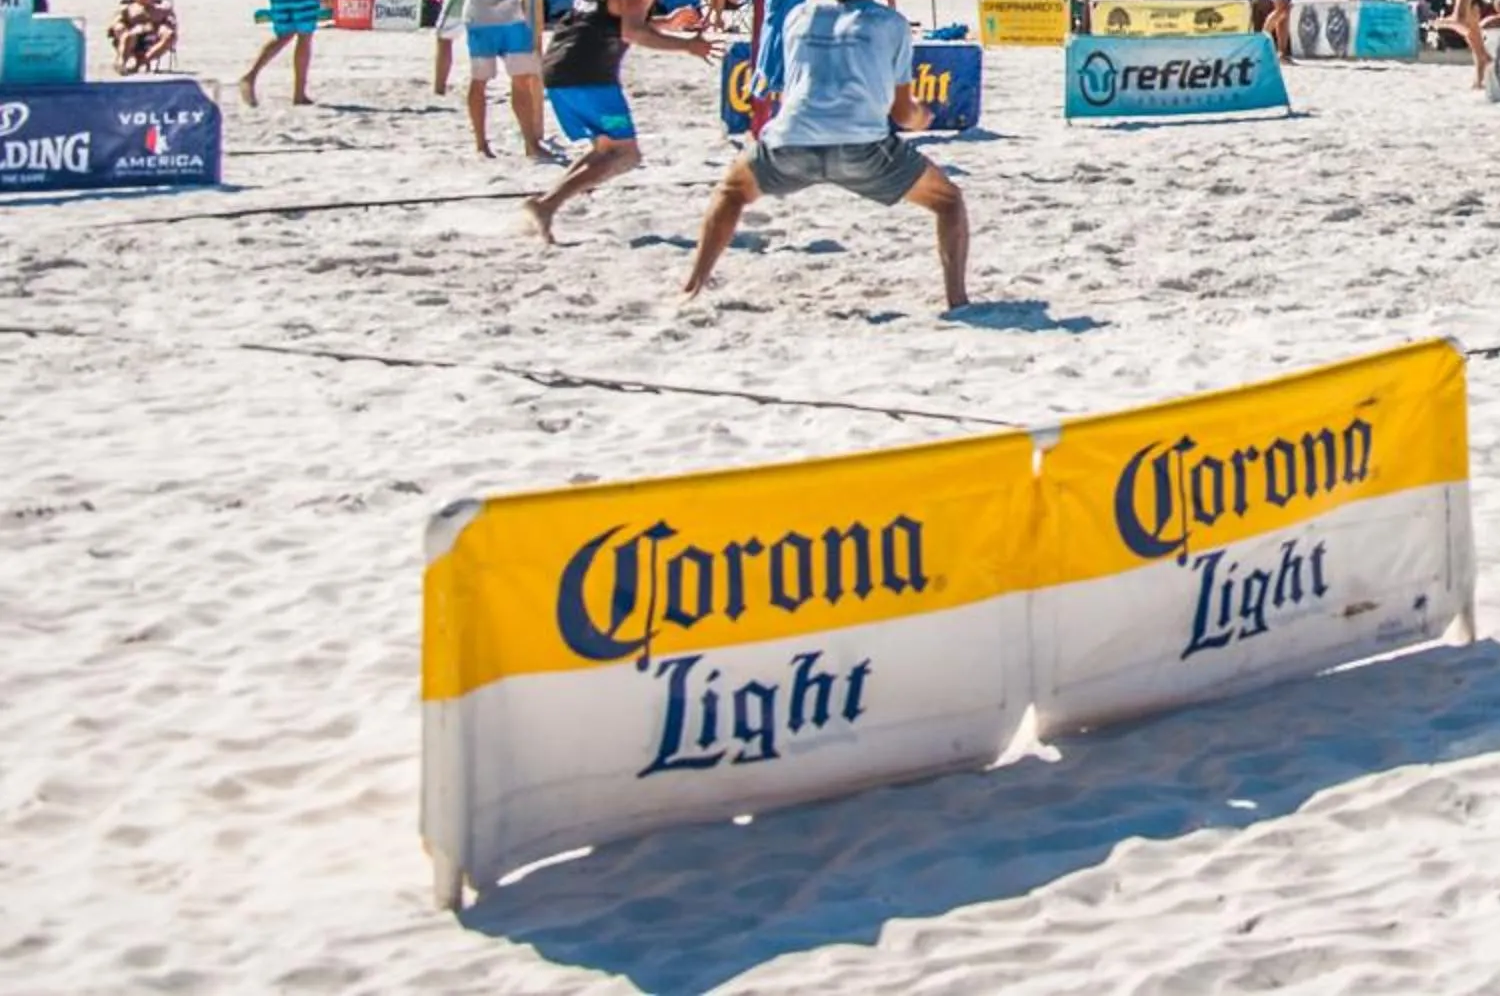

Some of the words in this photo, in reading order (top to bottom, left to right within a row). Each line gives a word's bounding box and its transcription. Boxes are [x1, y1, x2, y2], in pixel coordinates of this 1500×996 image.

[115, 155, 204, 169] AMERICA
[118, 111, 204, 125] VOLLEY
[1114, 416, 1373, 566] Corona
[556, 514, 930, 672] Corona
[1180, 539, 1330, 661] Light
[636, 650, 873, 779] Light
